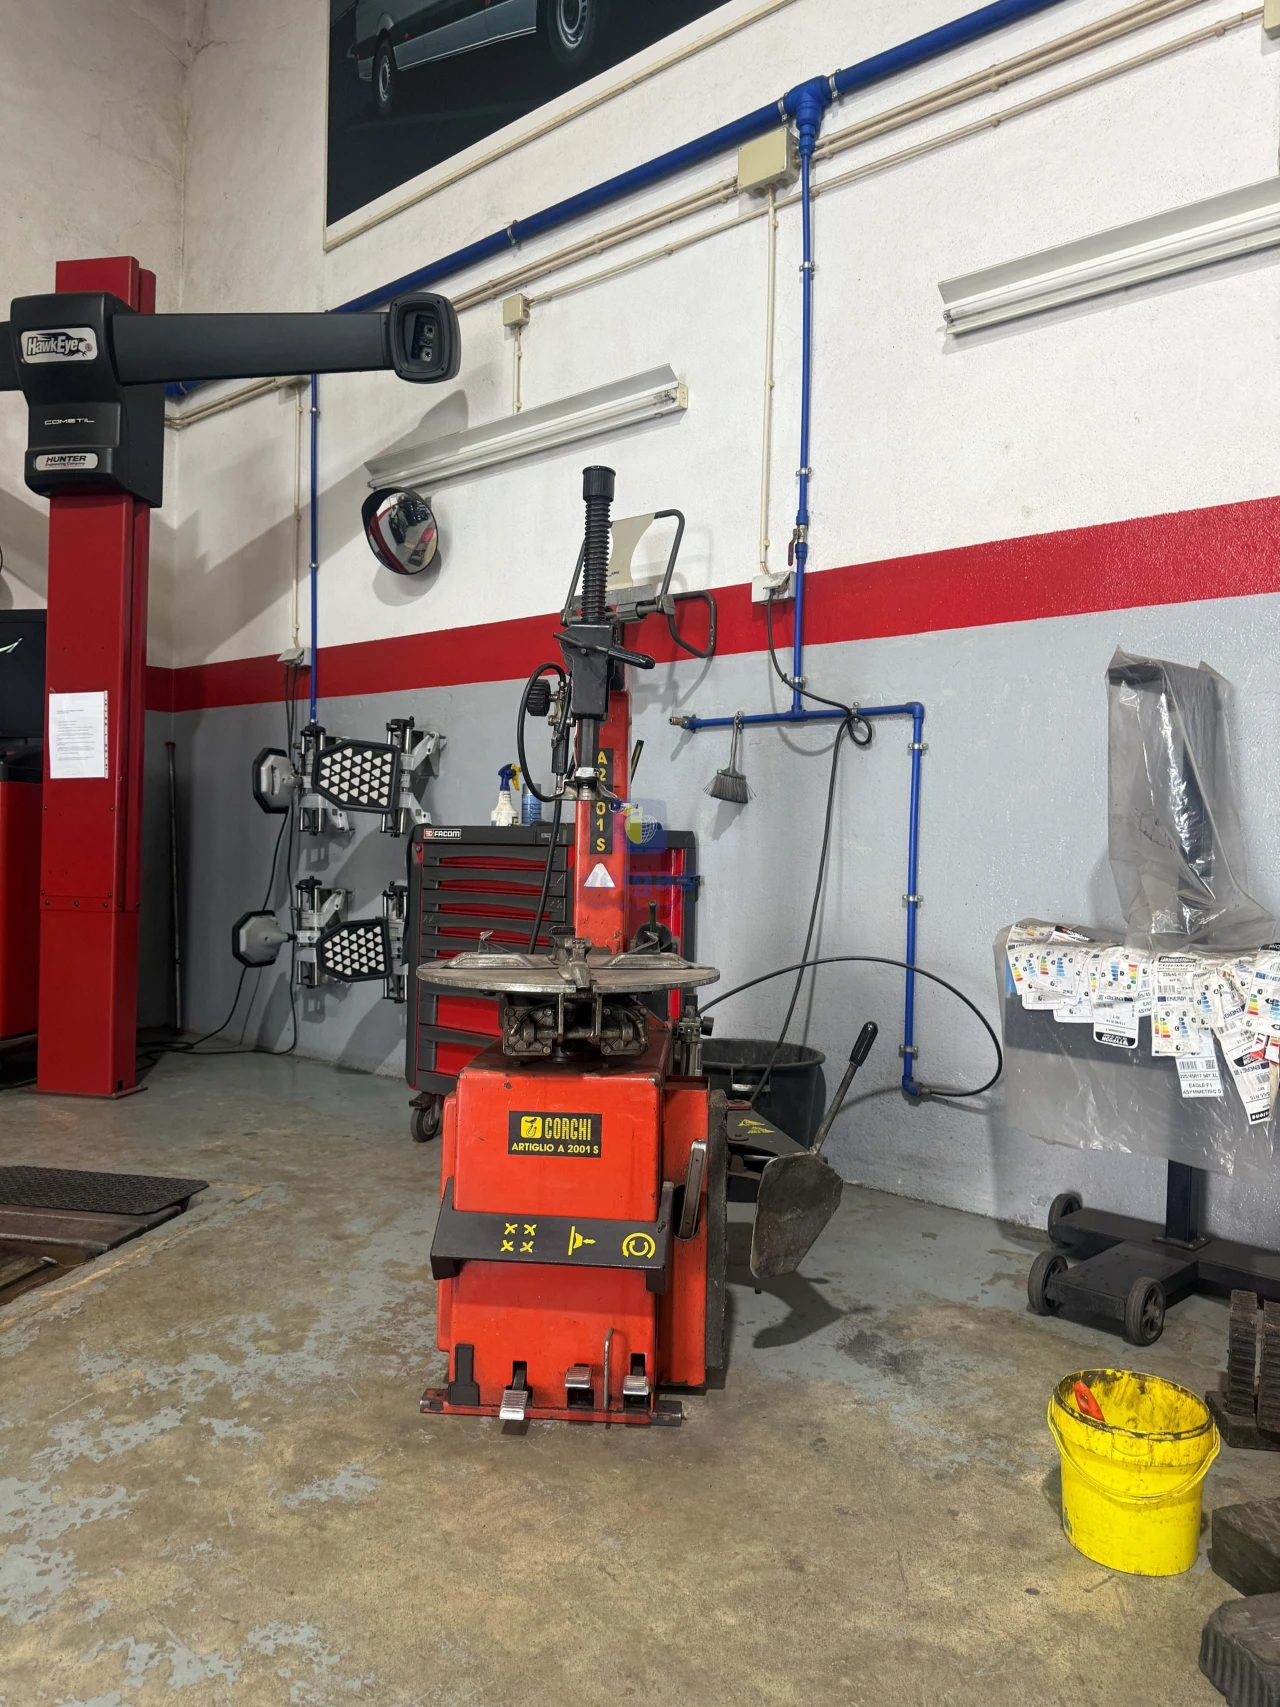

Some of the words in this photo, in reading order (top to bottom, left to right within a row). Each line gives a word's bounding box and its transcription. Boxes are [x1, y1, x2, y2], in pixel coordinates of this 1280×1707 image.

[27, 336, 79, 355] HawkEye
[46, 455, 87, 463] HUNTER
[434, 830, 460, 838] FACOM
[511, 1142, 554, 1152] ARTIGLIO
[557, 1144, 565, 1153] A
[567, 1144, 591, 1153] 2001
[593, 1145, 599, 1154] S
